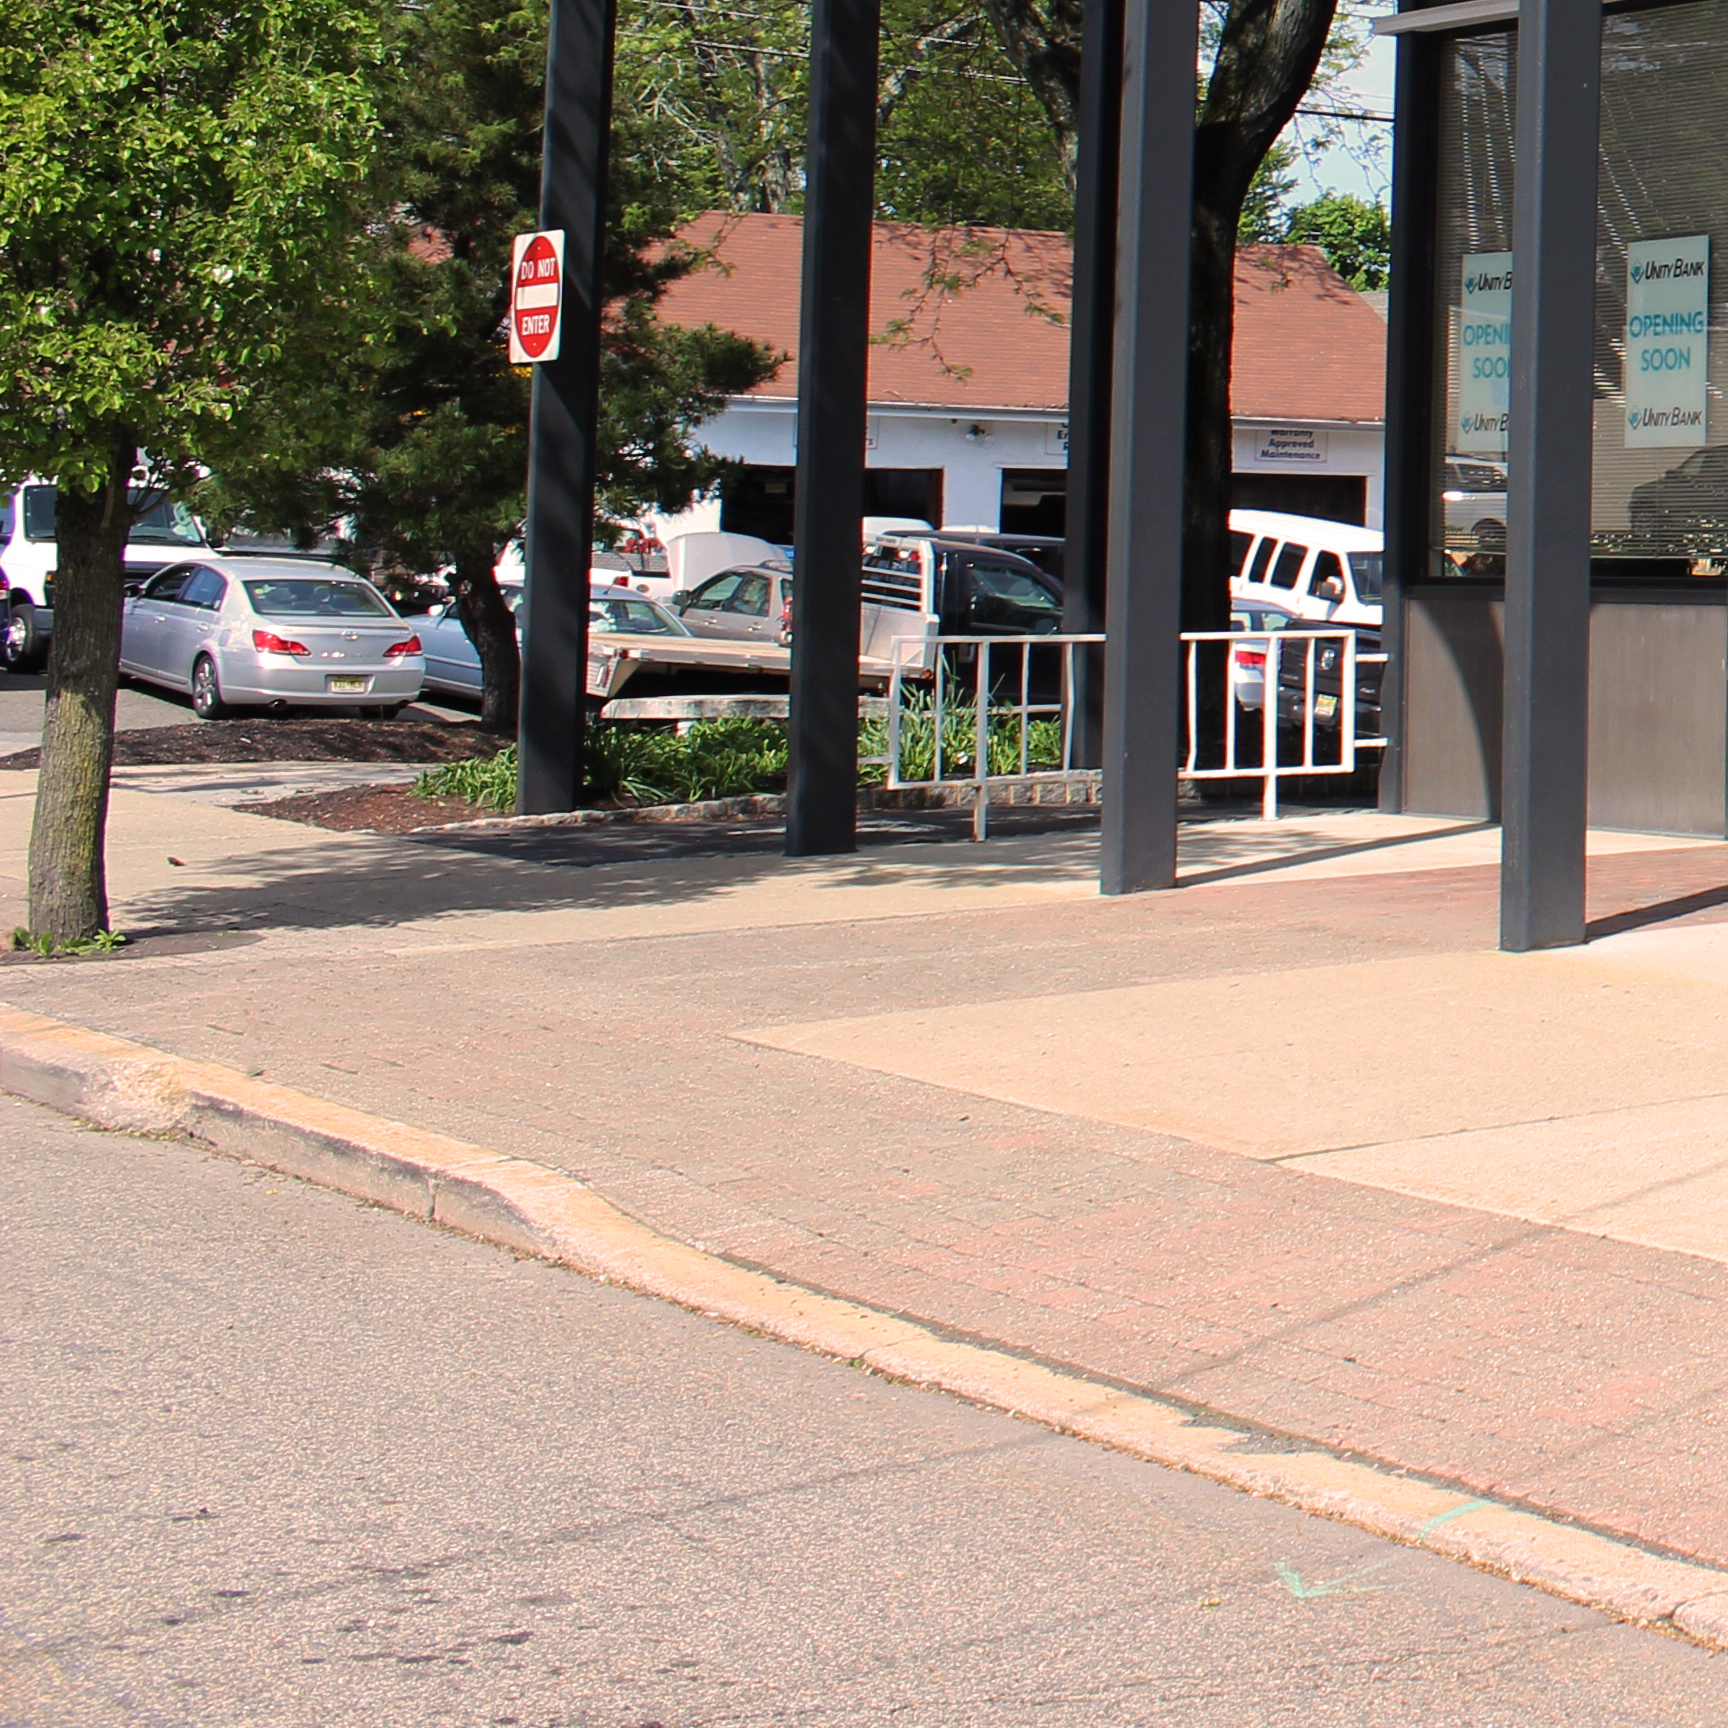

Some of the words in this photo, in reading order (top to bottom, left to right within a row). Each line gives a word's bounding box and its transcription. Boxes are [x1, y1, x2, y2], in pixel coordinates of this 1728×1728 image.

[521, 260, 535, 281] DO
[537, 257, 556, 278] NOT
[522, 314, 550, 336] ENTER
[1462, 323, 1511, 346] OPENI
[1628, 311, 1704, 338] OPENING
[1472, 356, 1511, 379] SOO
[1640, 346, 1691, 372] SOON
[1260, 449, 1320, 459] Maintenance
[1268, 439, 1314, 449] Approved
